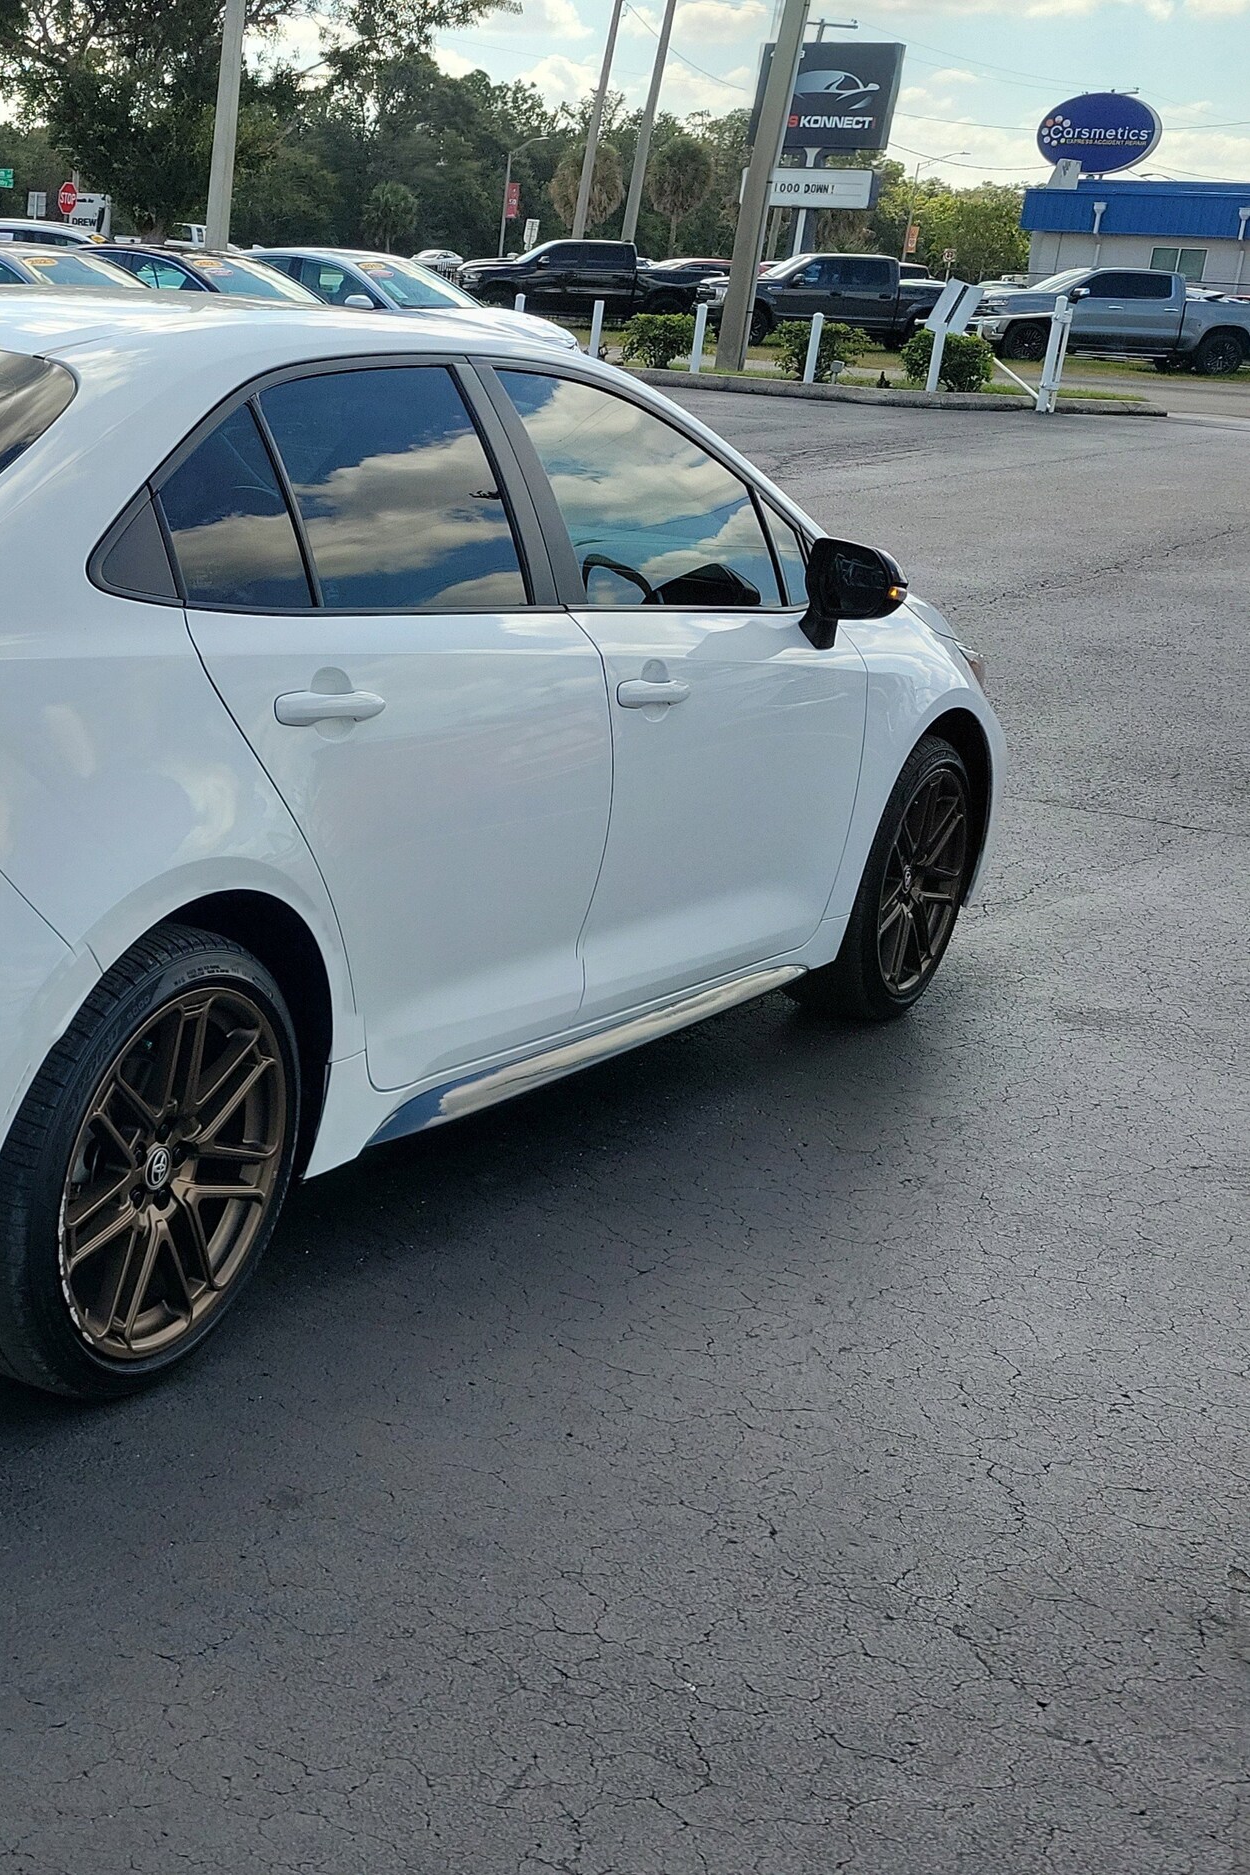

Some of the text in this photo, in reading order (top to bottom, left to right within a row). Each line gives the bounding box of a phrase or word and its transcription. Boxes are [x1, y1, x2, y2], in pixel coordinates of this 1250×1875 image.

[1050, 125, 1148, 141] Carsmetics
[59, 191, 76, 205] STOP
[71, 217, 98, 227] DREW
